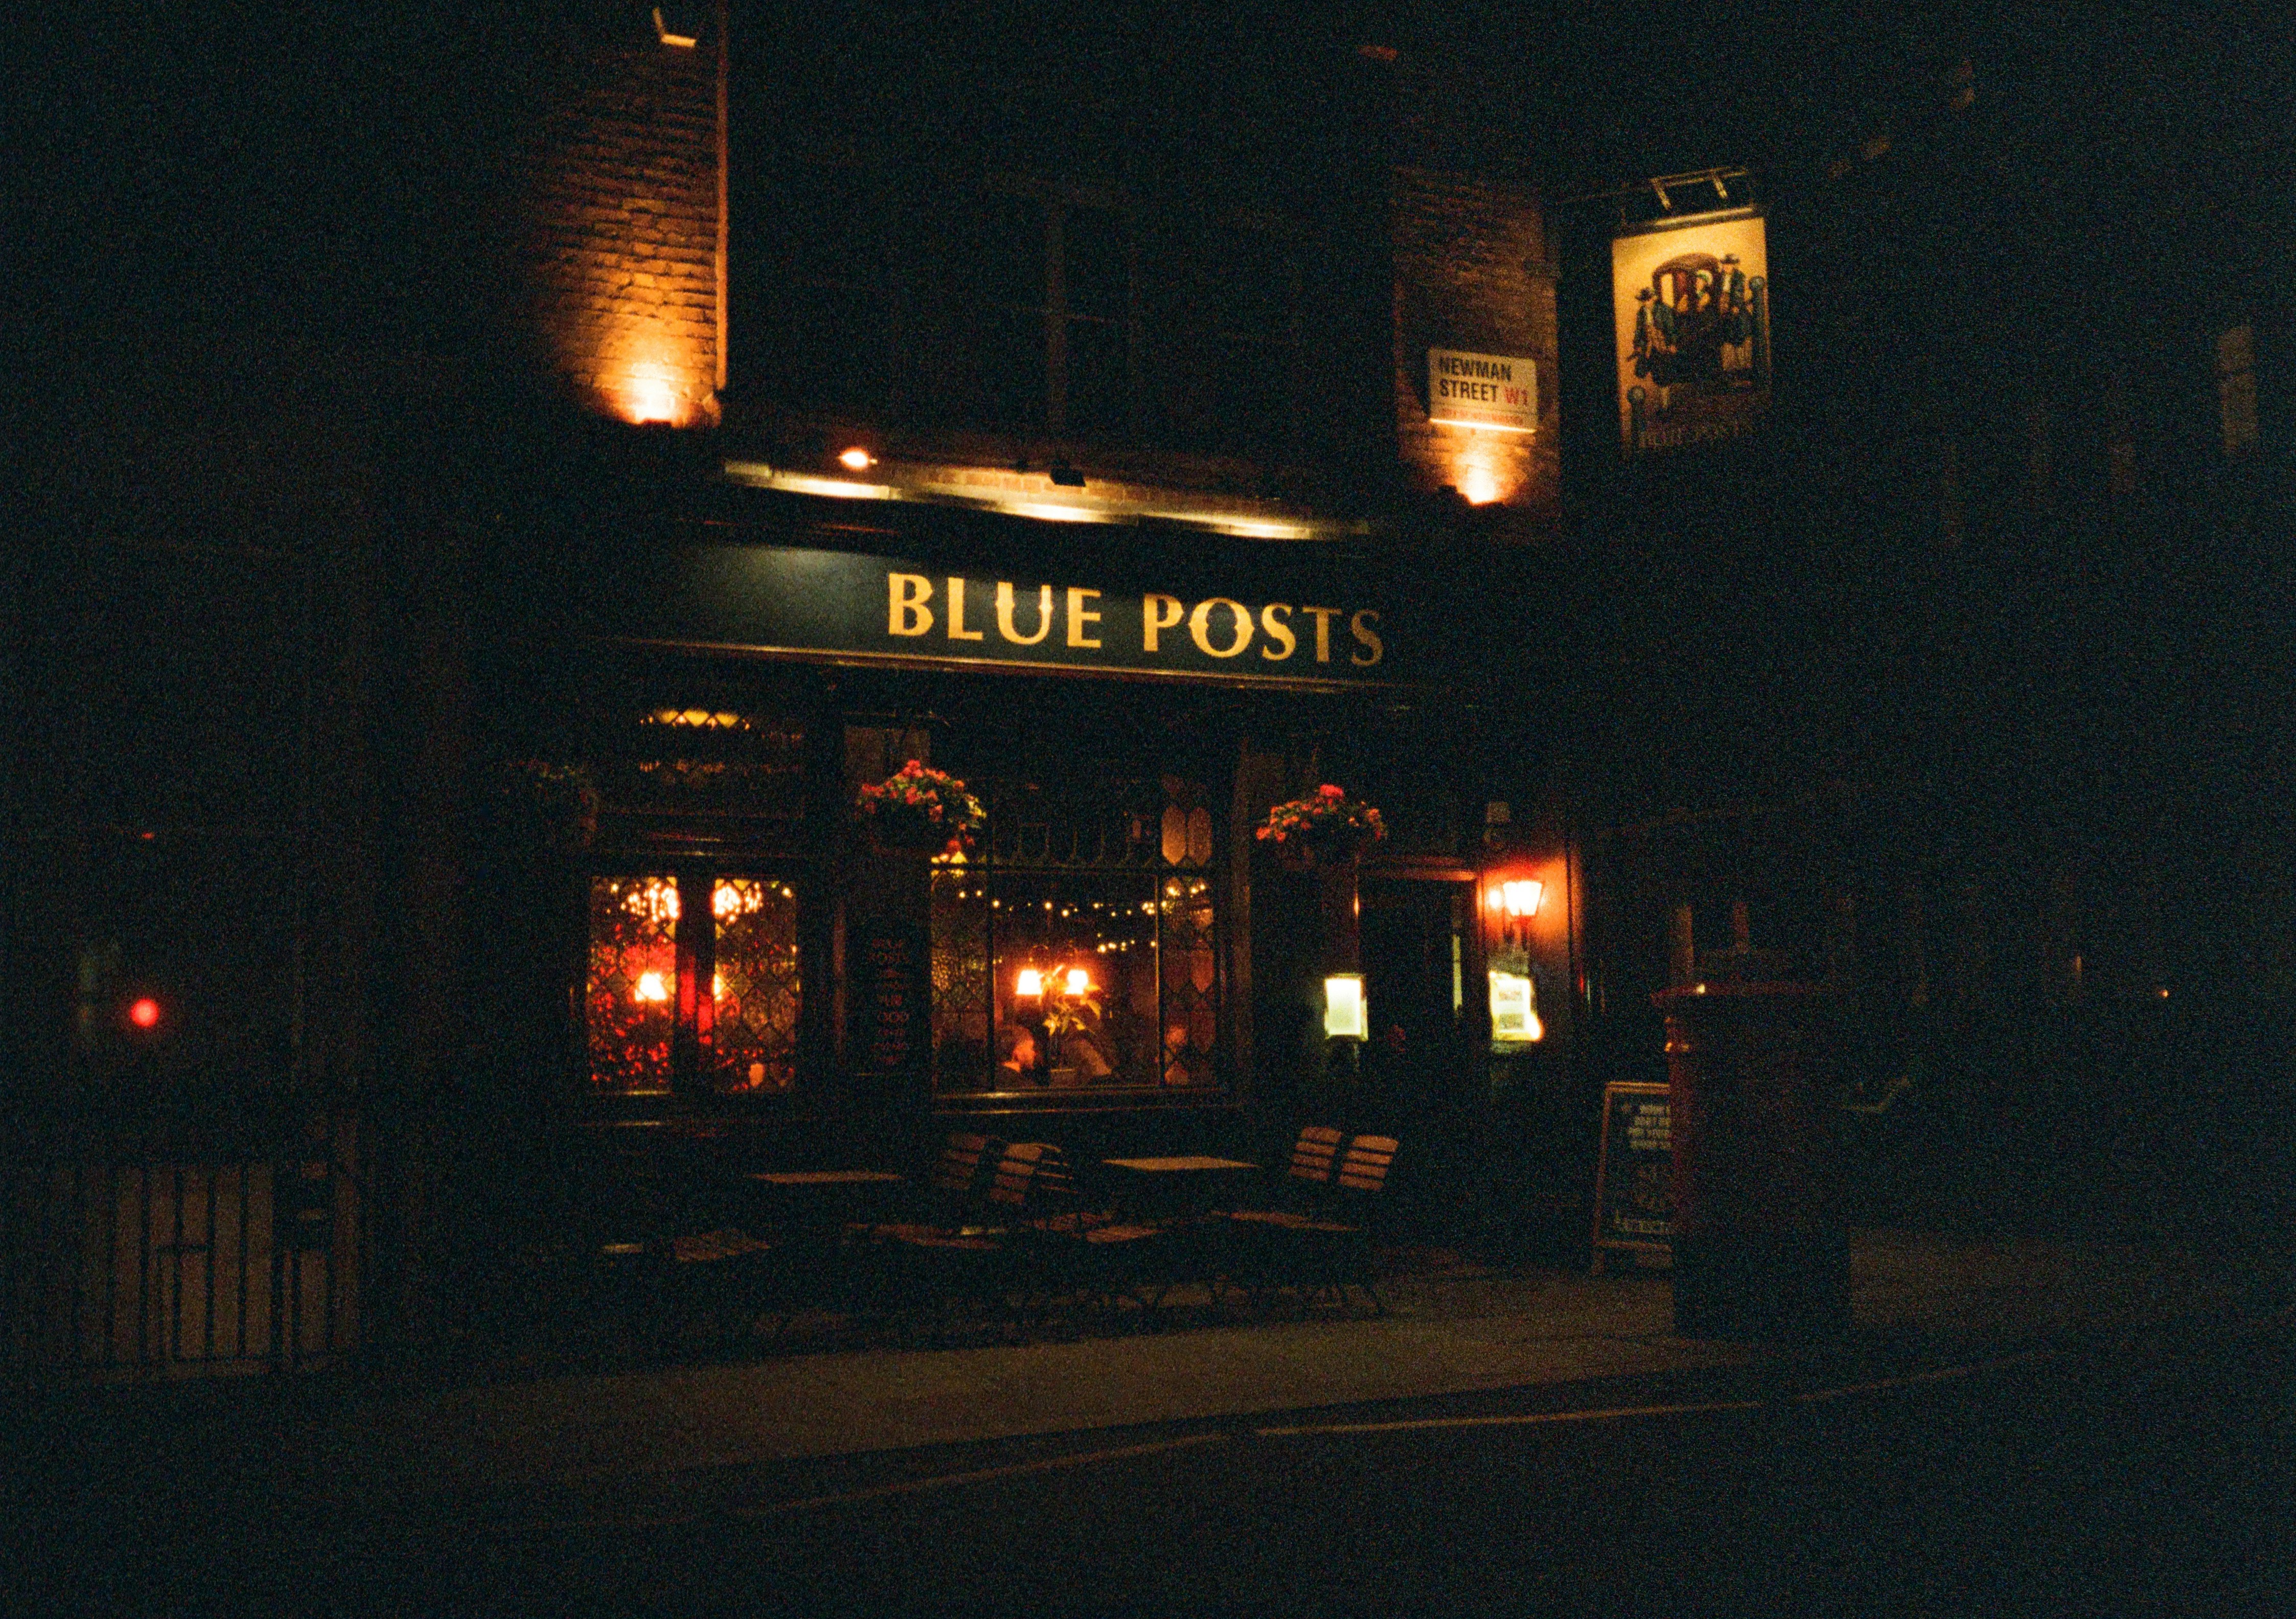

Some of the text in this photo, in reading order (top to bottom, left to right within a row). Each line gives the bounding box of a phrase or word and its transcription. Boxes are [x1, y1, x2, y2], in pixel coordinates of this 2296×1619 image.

[1439, 357, 1511, 381] NEWMAN
[1439, 379, 1528, 405] STREET W1
[887, 572, 1384, 667] BLUE POSTS
